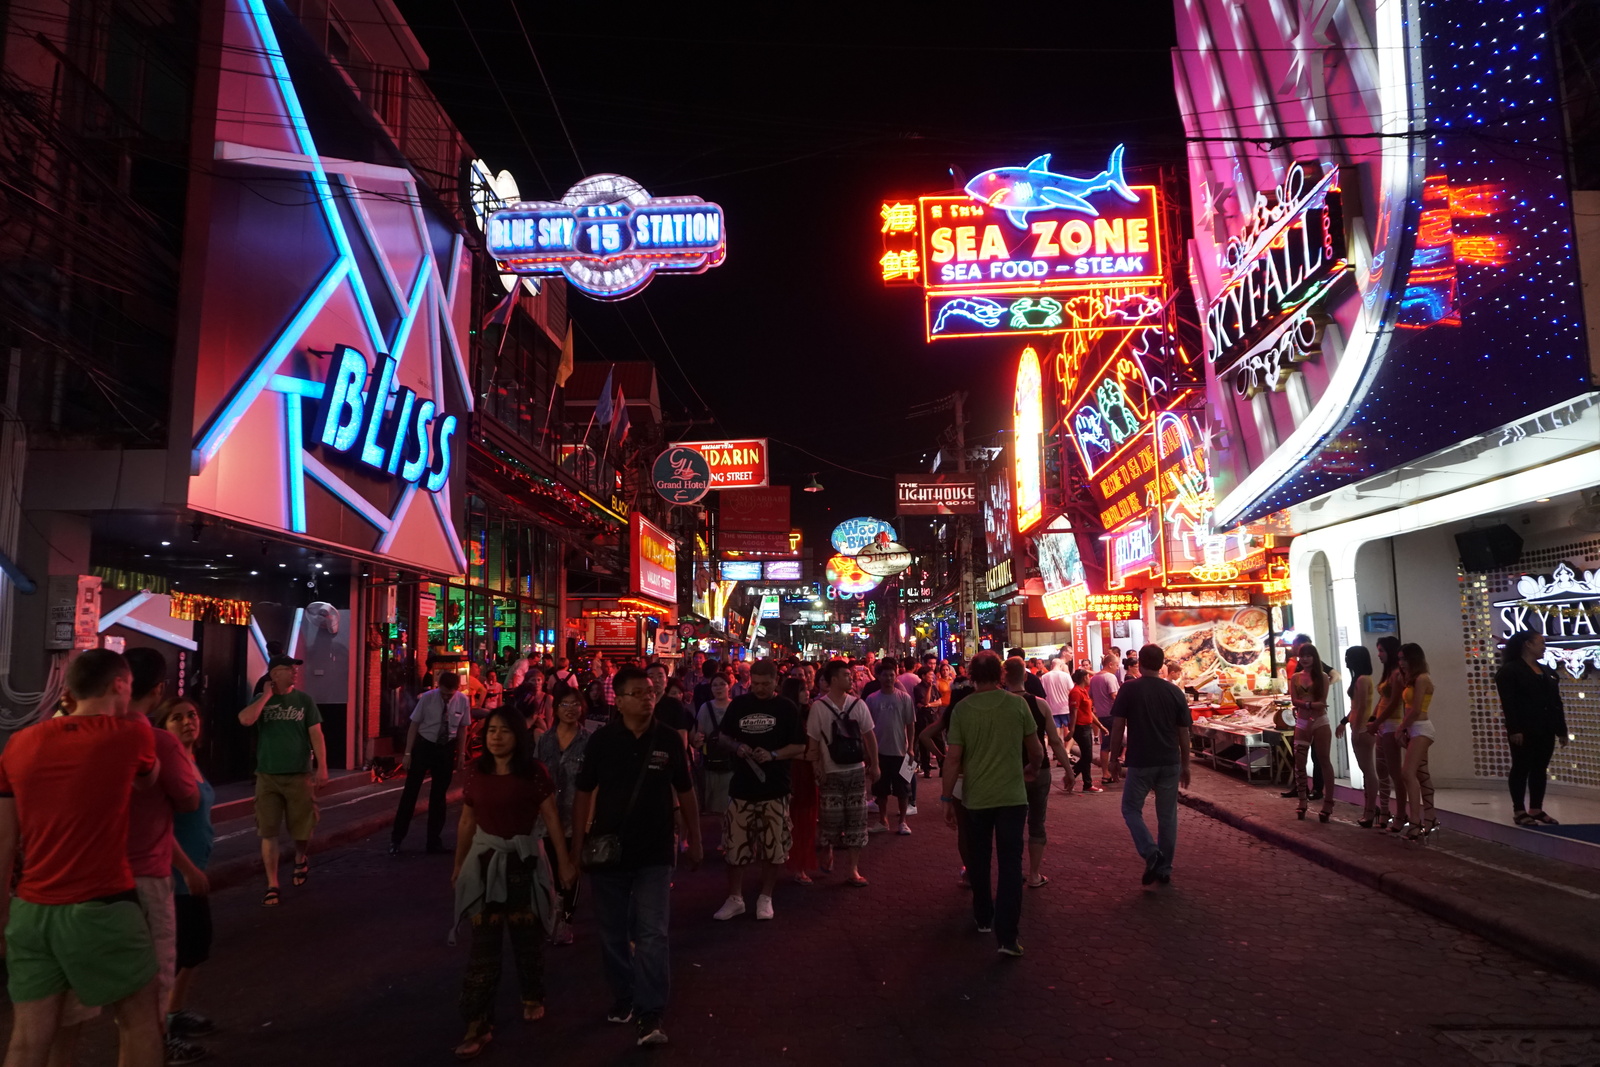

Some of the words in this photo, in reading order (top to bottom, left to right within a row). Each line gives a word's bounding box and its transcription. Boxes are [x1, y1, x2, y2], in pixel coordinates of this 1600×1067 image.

[491, 217, 534, 247] BLUE
[538, 217, 574, 246] SKY
[586, 224, 620, 251] 15
[636, 213, 719, 243] STATION
[930, 224, 1010, 263] SEA
[1031, 218, 1150, 259] ZONE
[941, 263, 982, 281] SEA
[990, 260, 1049, 279] FOOD
[1074, 256, 1144, 274] STEAK
[1206, 209, 1323, 364] SKYFALL
[321, 344, 457, 493] BLISS
[656, 480, 682, 489] Grand
[684, 480, 707, 489] Hotel
[726, 471, 753, 481] STREET
[899, 487, 975, 500] LIGHTHOUSE
[747, 586, 810, 596] ALCATRAZ
[1500, 602, 1600, 639] SKYFA
